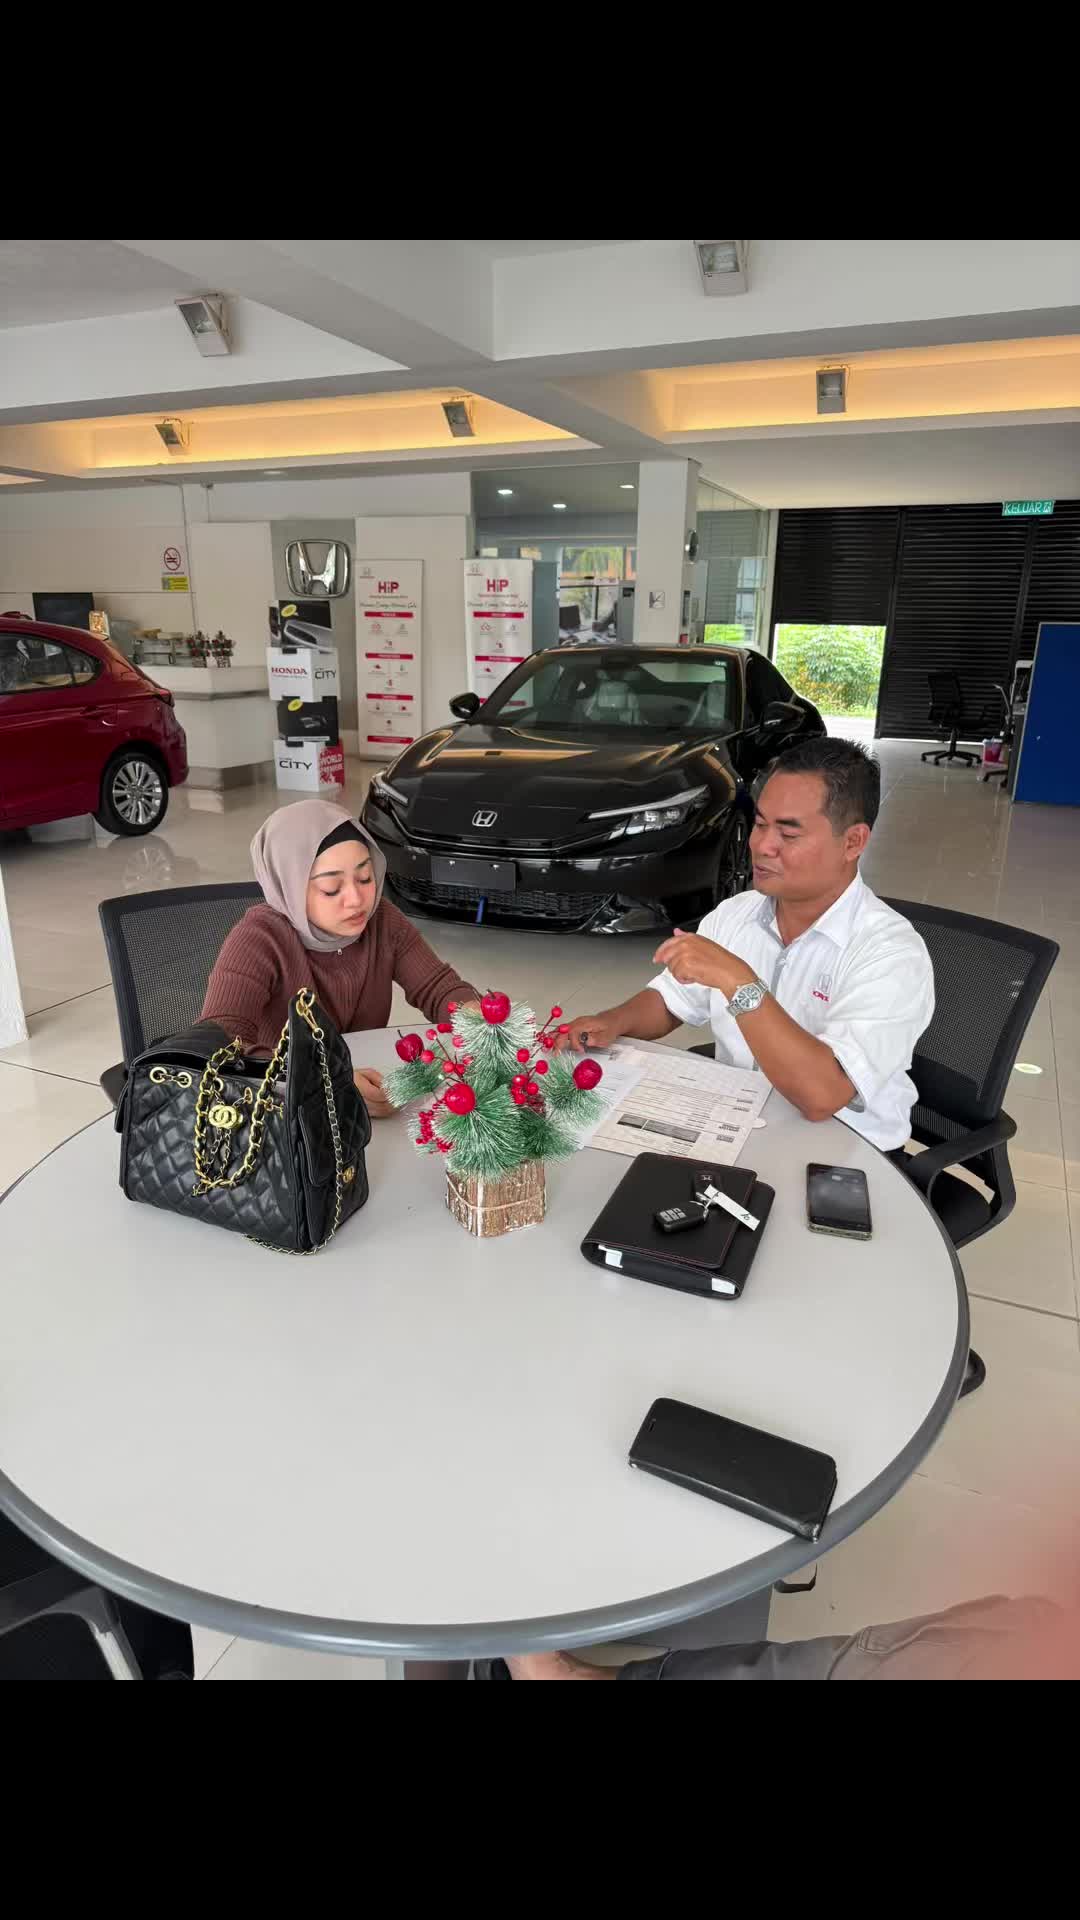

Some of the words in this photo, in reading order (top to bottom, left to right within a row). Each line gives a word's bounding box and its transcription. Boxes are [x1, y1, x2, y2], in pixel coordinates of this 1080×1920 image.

[1005, 502, 1041, 513] KELUAR
[271, 667, 307, 675] HONDA
[315, 669, 336, 679] CITY
[279, 760, 312, 770] CITY
